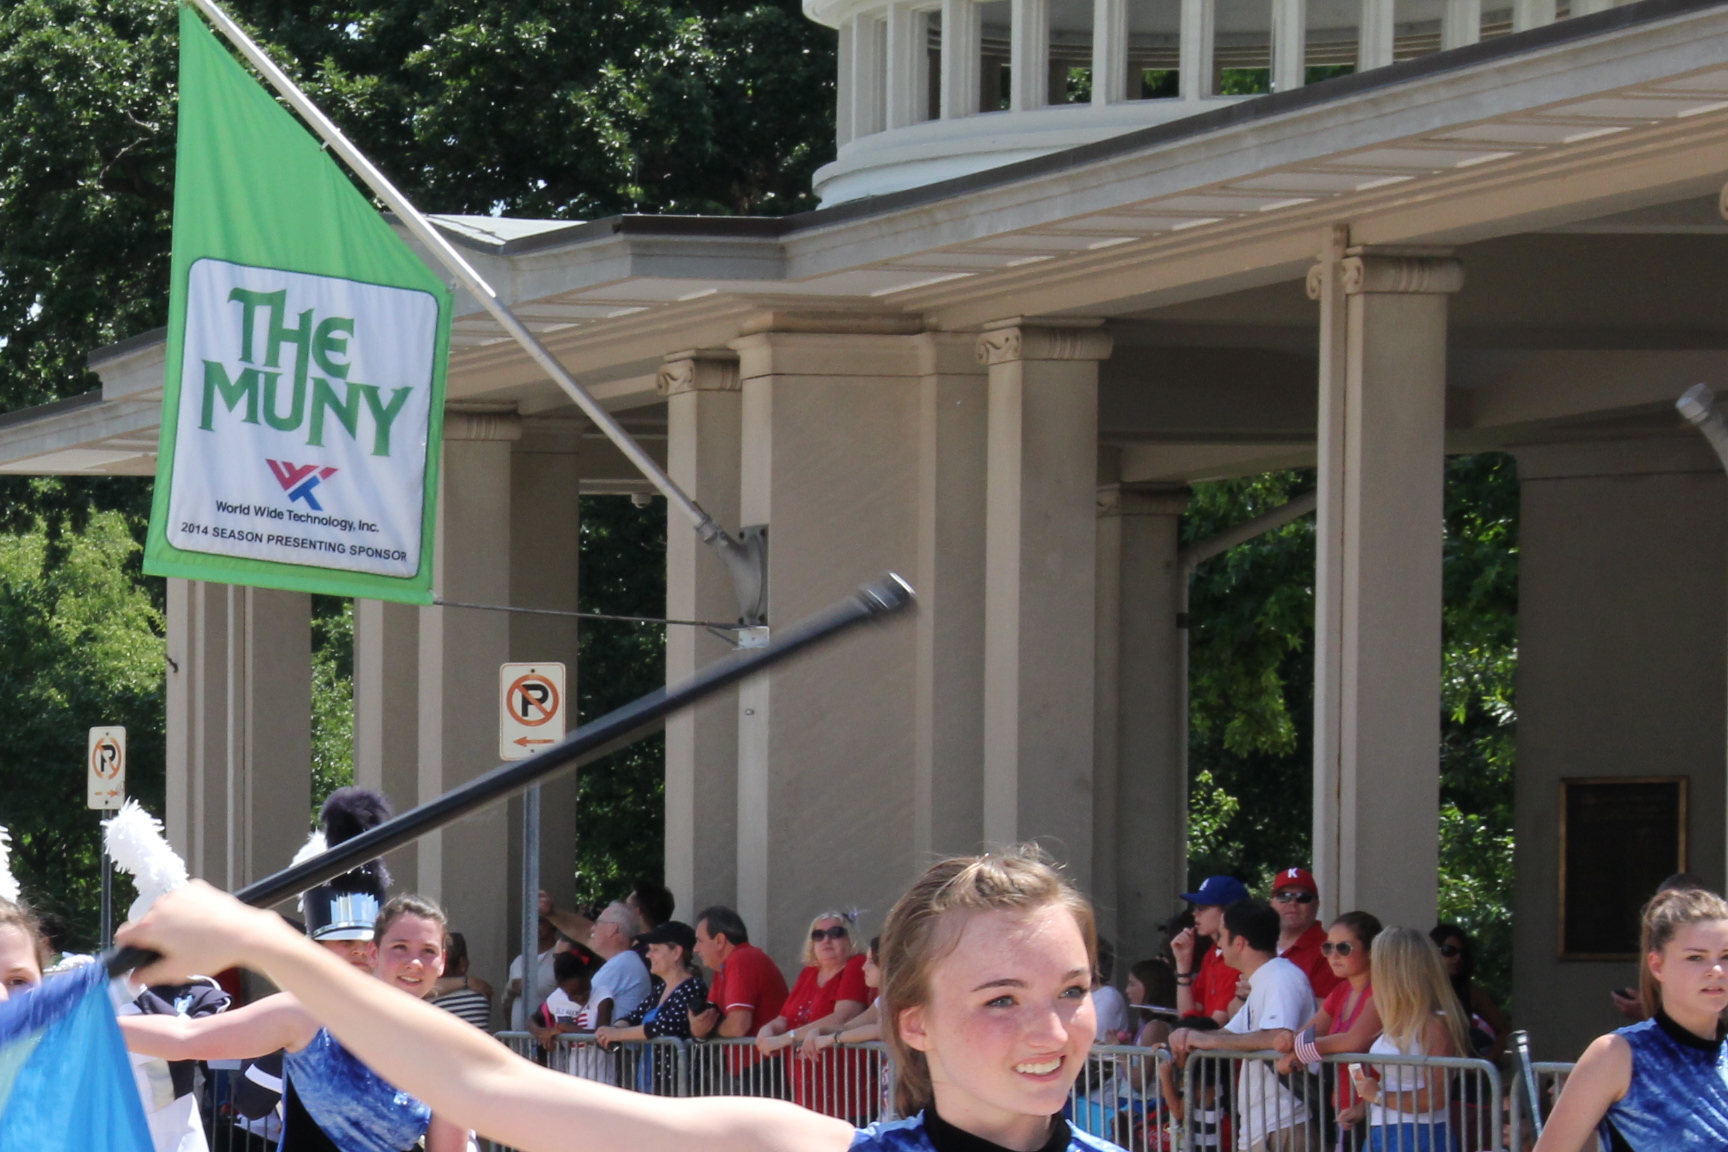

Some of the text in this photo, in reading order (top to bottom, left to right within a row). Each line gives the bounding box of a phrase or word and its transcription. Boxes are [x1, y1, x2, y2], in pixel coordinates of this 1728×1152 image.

[227, 287, 355, 379] THE
[198, 359, 414, 457] MUNY
[216, 500, 380, 533] World Wide Technology, Inc.
[181, 522, 407, 563] 2014 SEASON PRESENTING SPONSOR
[1287, 867, 1298, 879] K
